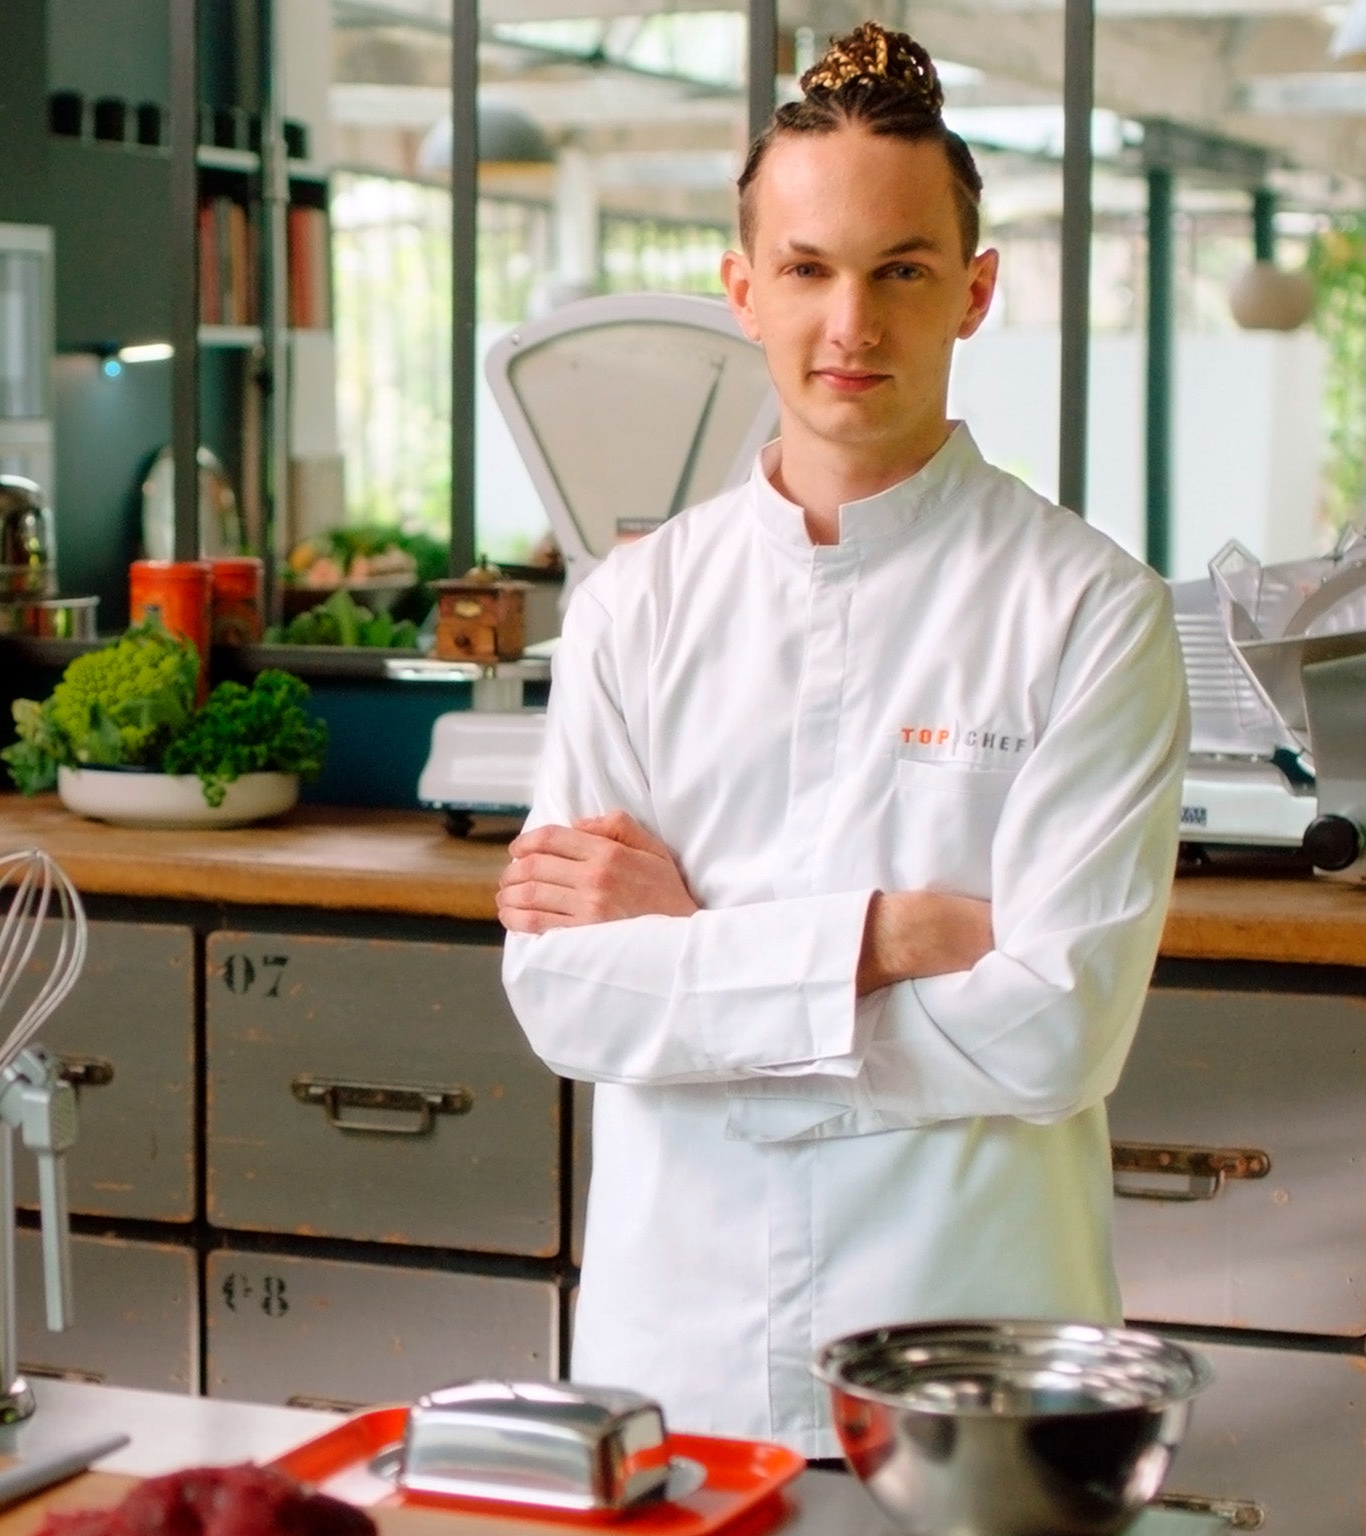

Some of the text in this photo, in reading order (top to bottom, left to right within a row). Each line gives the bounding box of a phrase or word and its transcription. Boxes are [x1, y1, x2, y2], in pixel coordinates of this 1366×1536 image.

[901, 727, 1027, 753] TOP CHEF
[223, 953, 289, 998] 07
